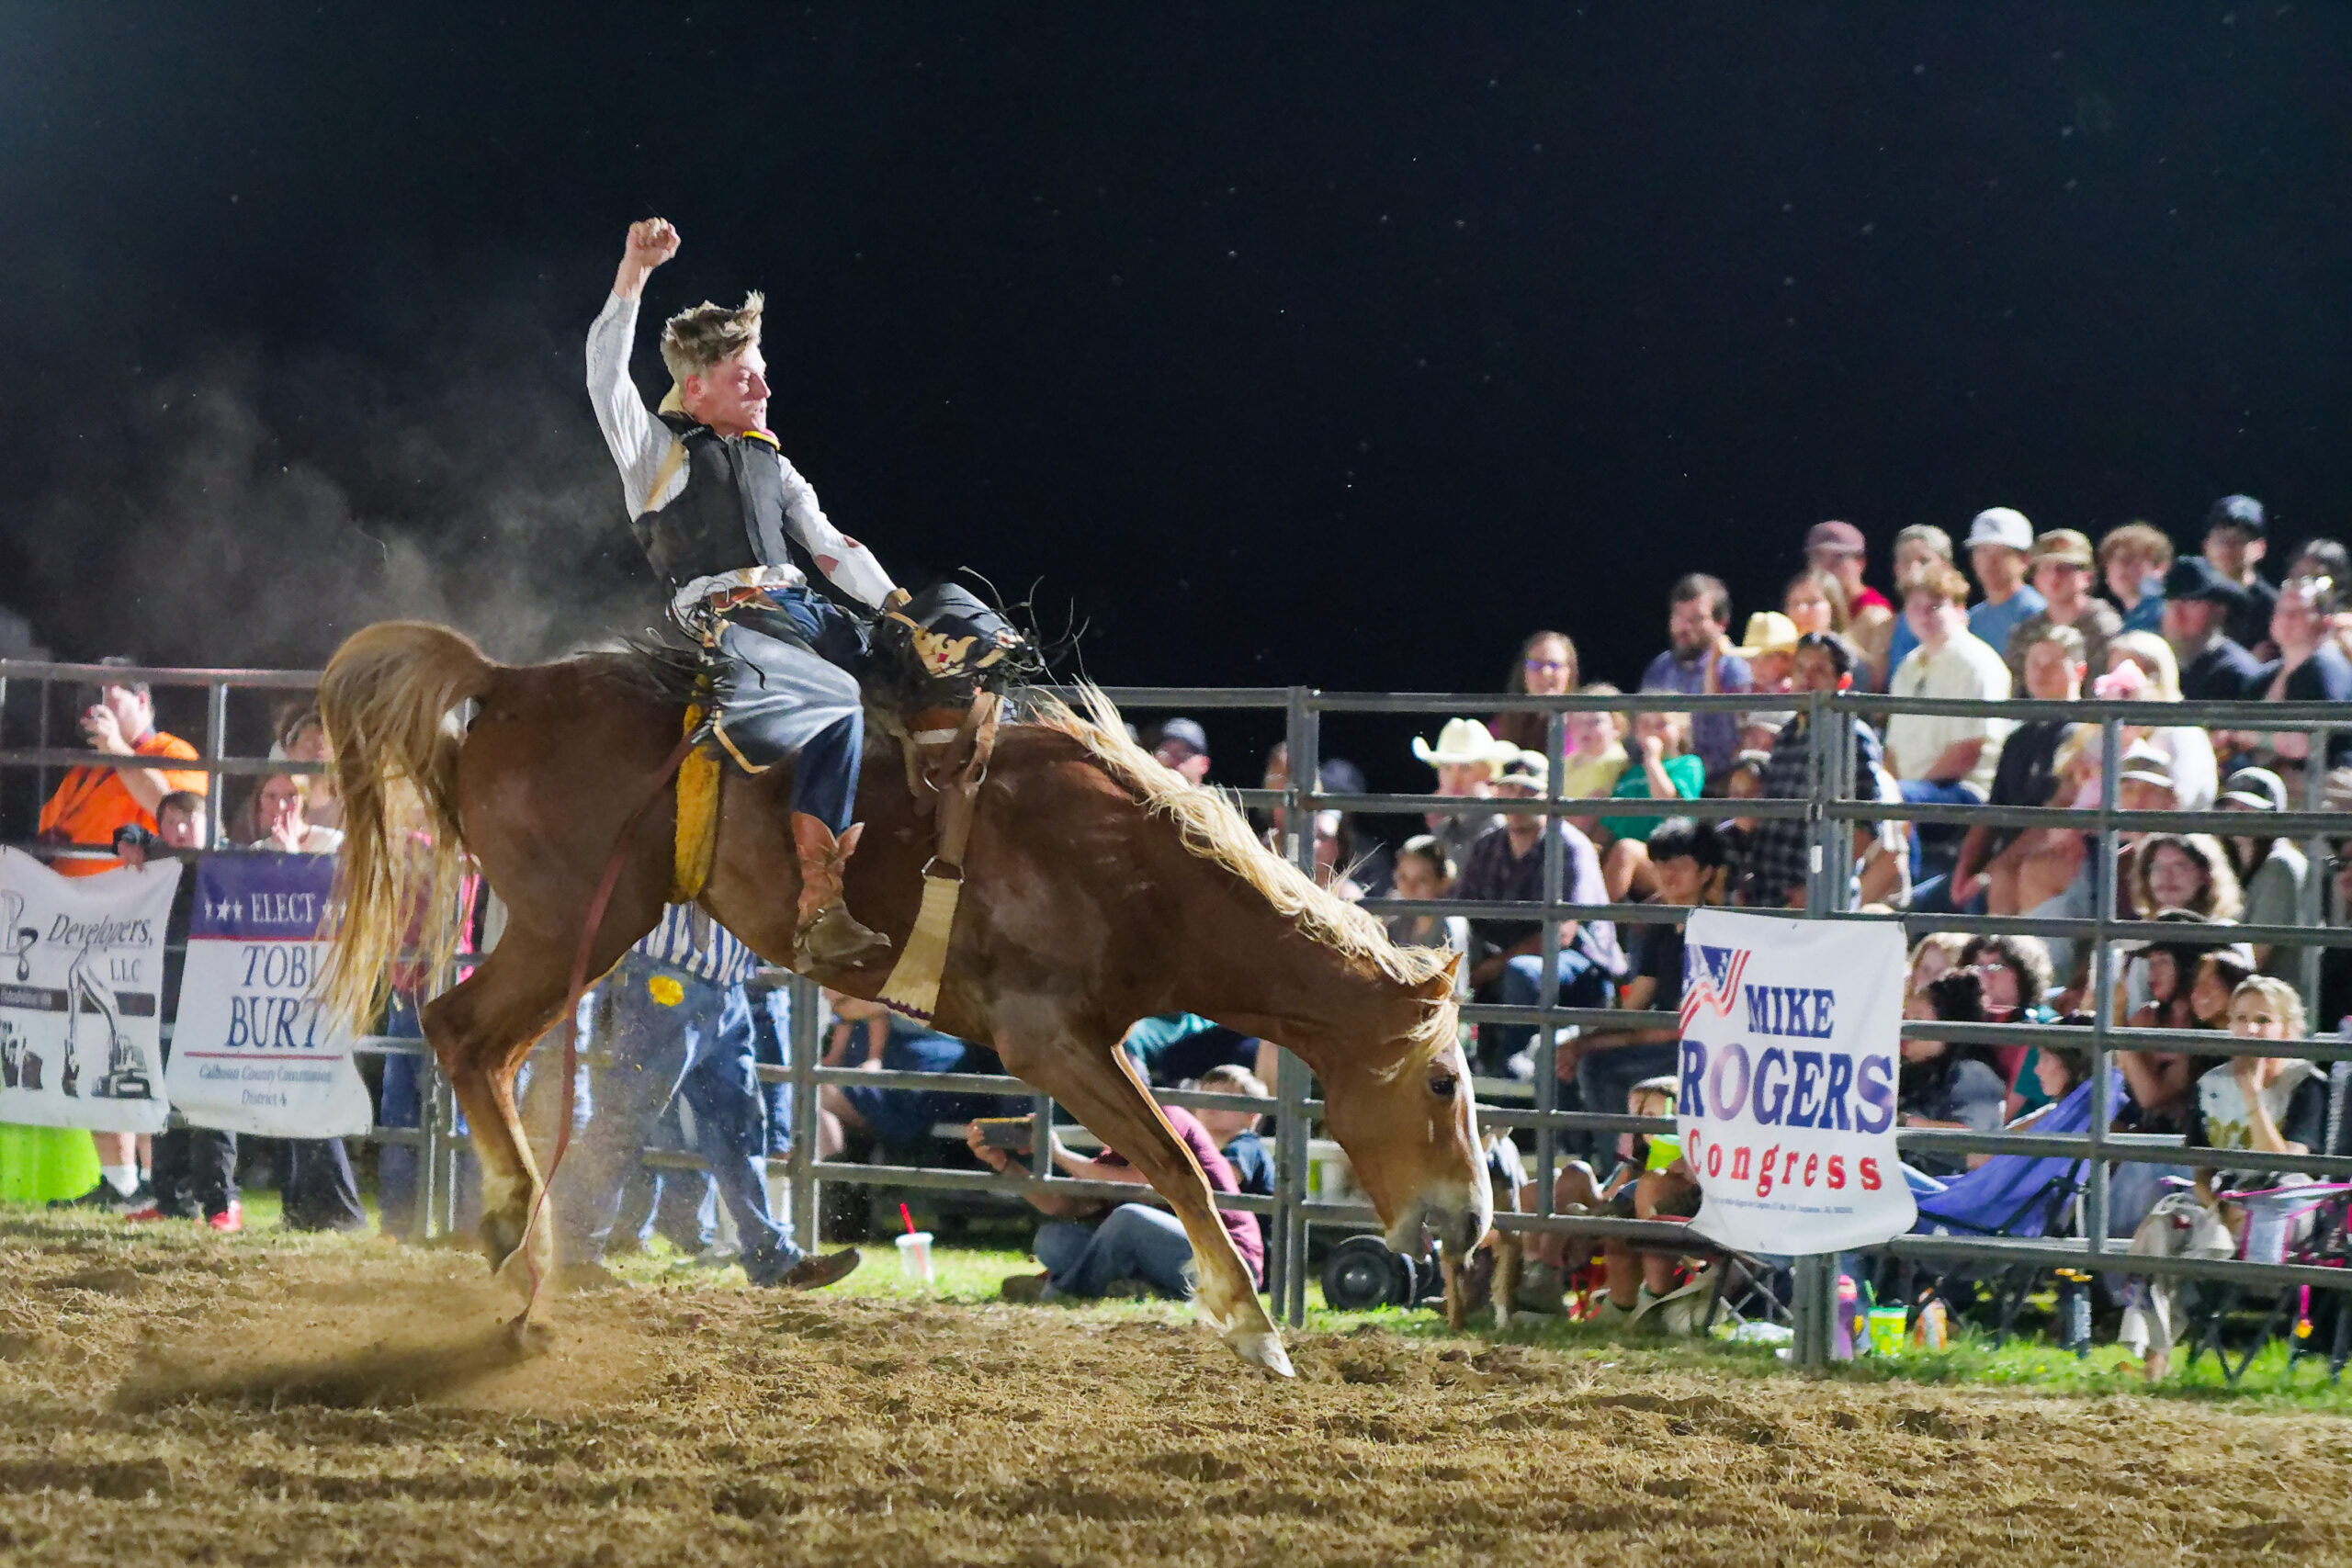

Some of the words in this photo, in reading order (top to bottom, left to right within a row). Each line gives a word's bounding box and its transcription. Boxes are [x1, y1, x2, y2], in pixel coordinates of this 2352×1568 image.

[251, 892, 316, 923] ELECT
[109, 957, 141, 983] LLC
[224, 995, 329, 1048] BURT
[1745, 984, 1836, 1039] MIKE
[1679, 1039, 1895, 1135] ROGERS
[1688, 1127, 1883, 1198] Congress
